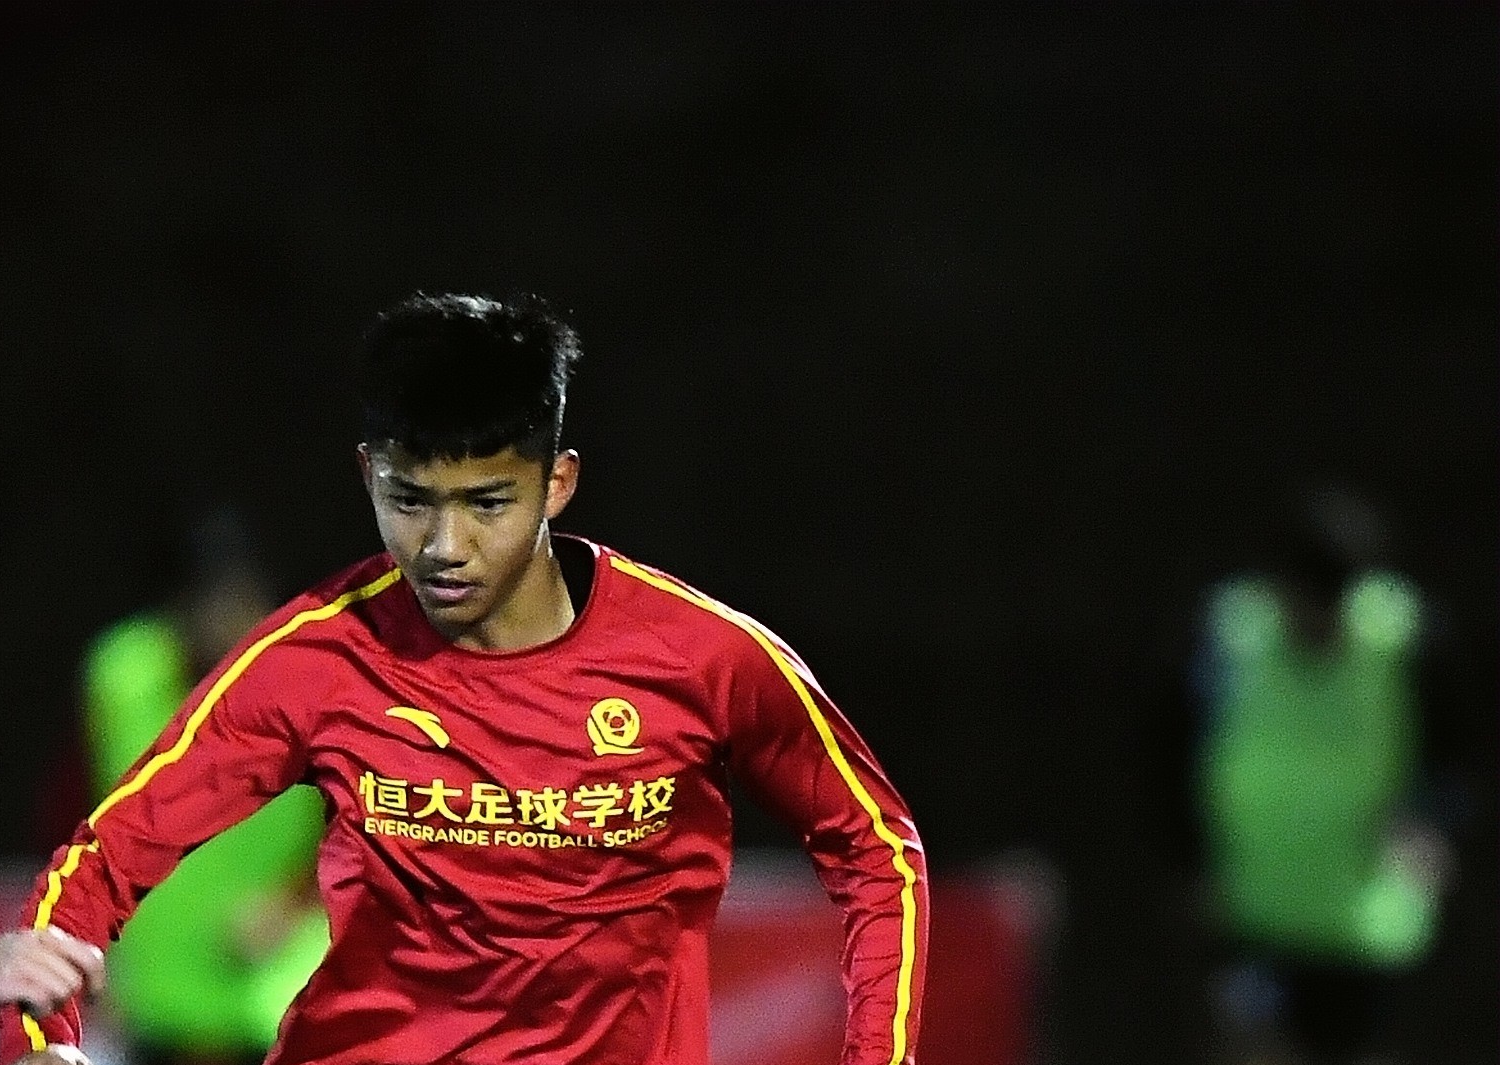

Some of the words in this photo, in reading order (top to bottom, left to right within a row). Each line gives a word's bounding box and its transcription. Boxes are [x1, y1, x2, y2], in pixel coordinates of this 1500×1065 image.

[358, 770, 676, 831] 恒大足球学校
[363, 817, 490, 847] EVERGRANDE
[494, 829, 598, 849] FOOTBALL
